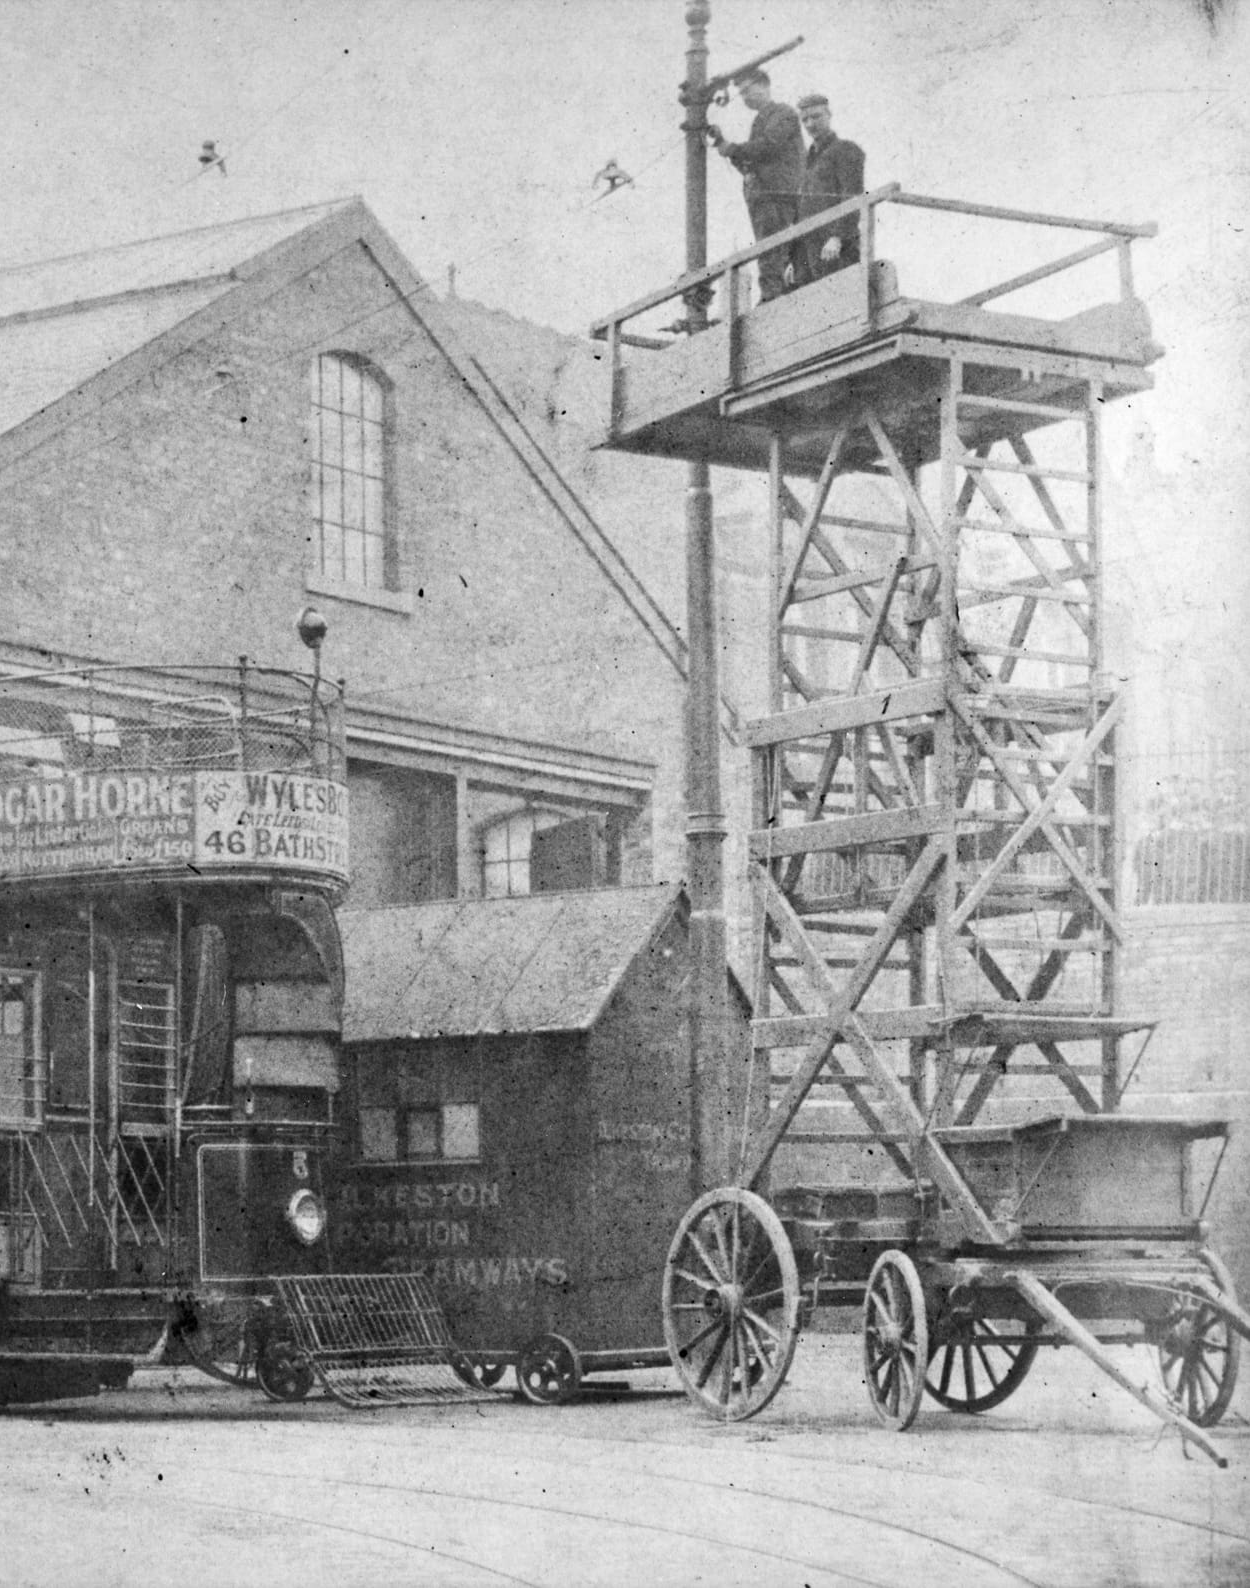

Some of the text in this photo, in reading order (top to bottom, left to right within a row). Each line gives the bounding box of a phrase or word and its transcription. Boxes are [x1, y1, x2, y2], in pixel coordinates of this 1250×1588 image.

[73, 773, 193, 819] HORNE
[203, 781, 230, 813] BUY
[246, 775, 326, 813] WYLES
[204, 830, 245, 854] 46
[254, 828, 314, 859] BATH
